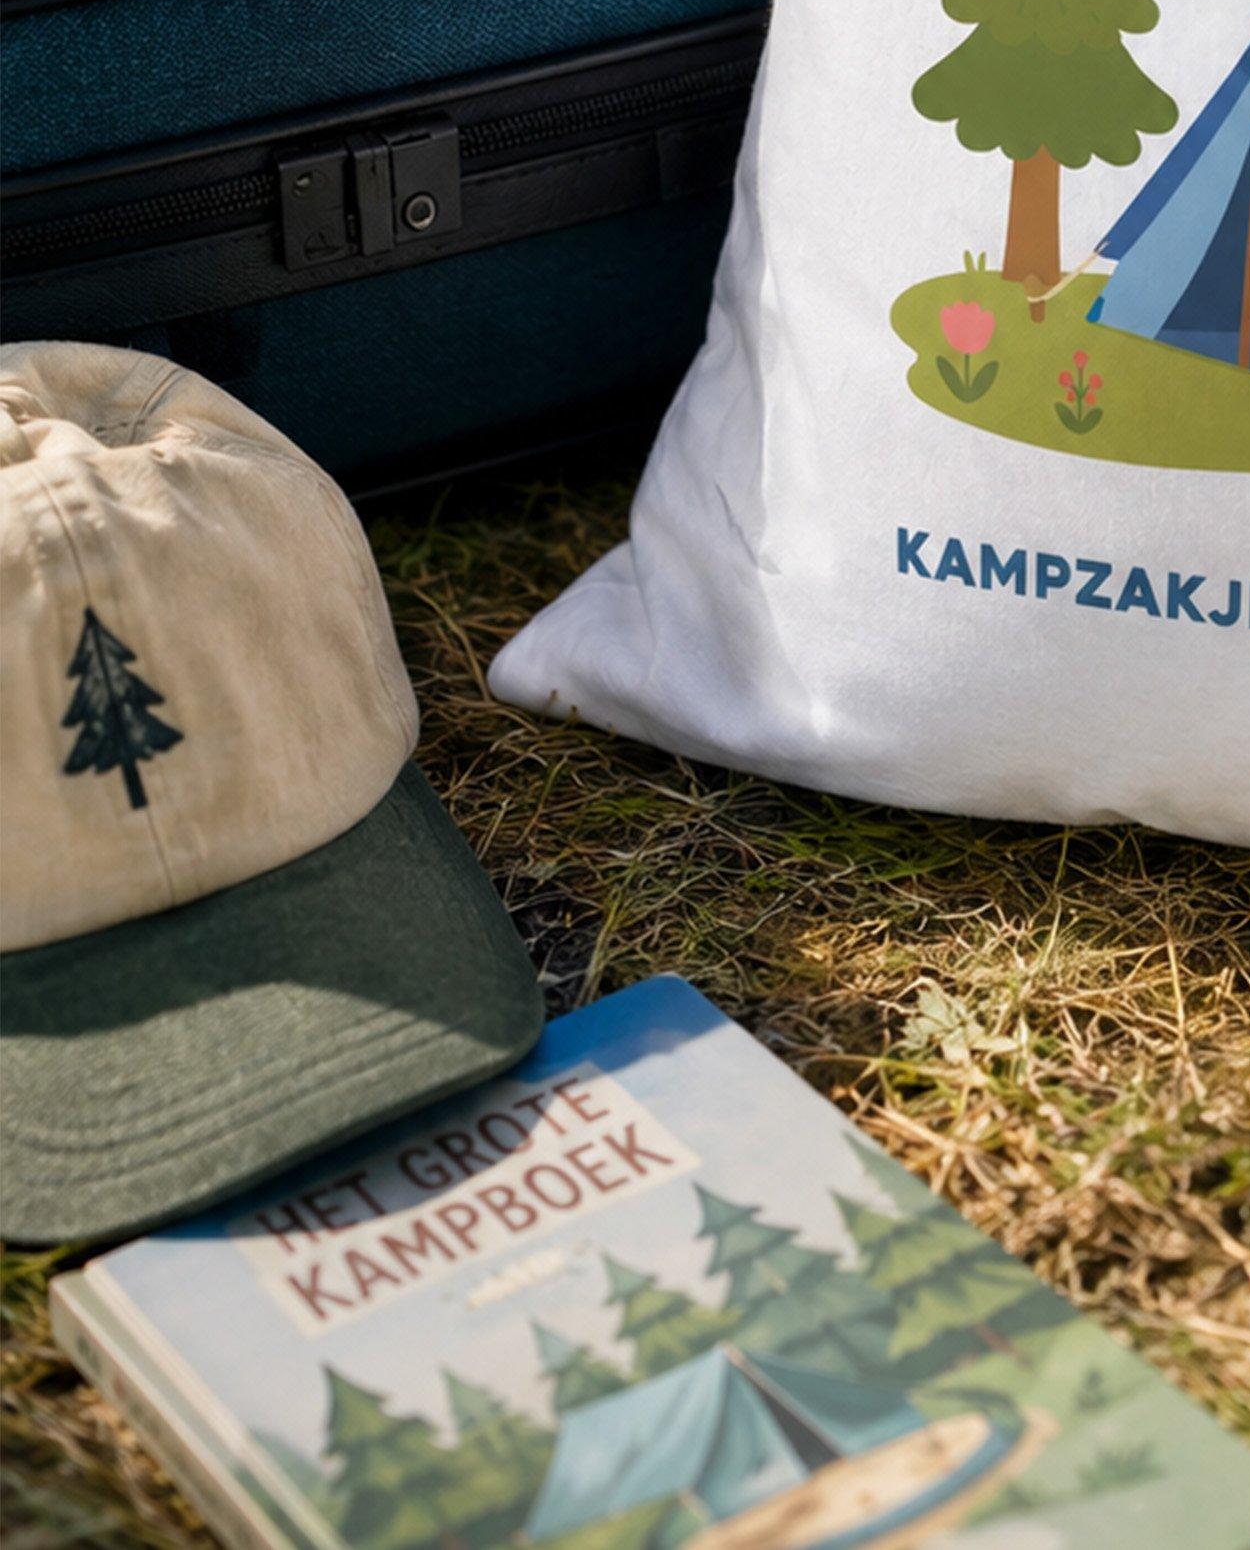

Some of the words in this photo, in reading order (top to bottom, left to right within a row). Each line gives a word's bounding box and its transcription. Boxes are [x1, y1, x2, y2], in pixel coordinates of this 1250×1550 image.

[257, 1170, 387, 1254] HET
[399, 1077, 609, 1191] GROTE
[287, 1123, 674, 1321] KAMPBOEK
